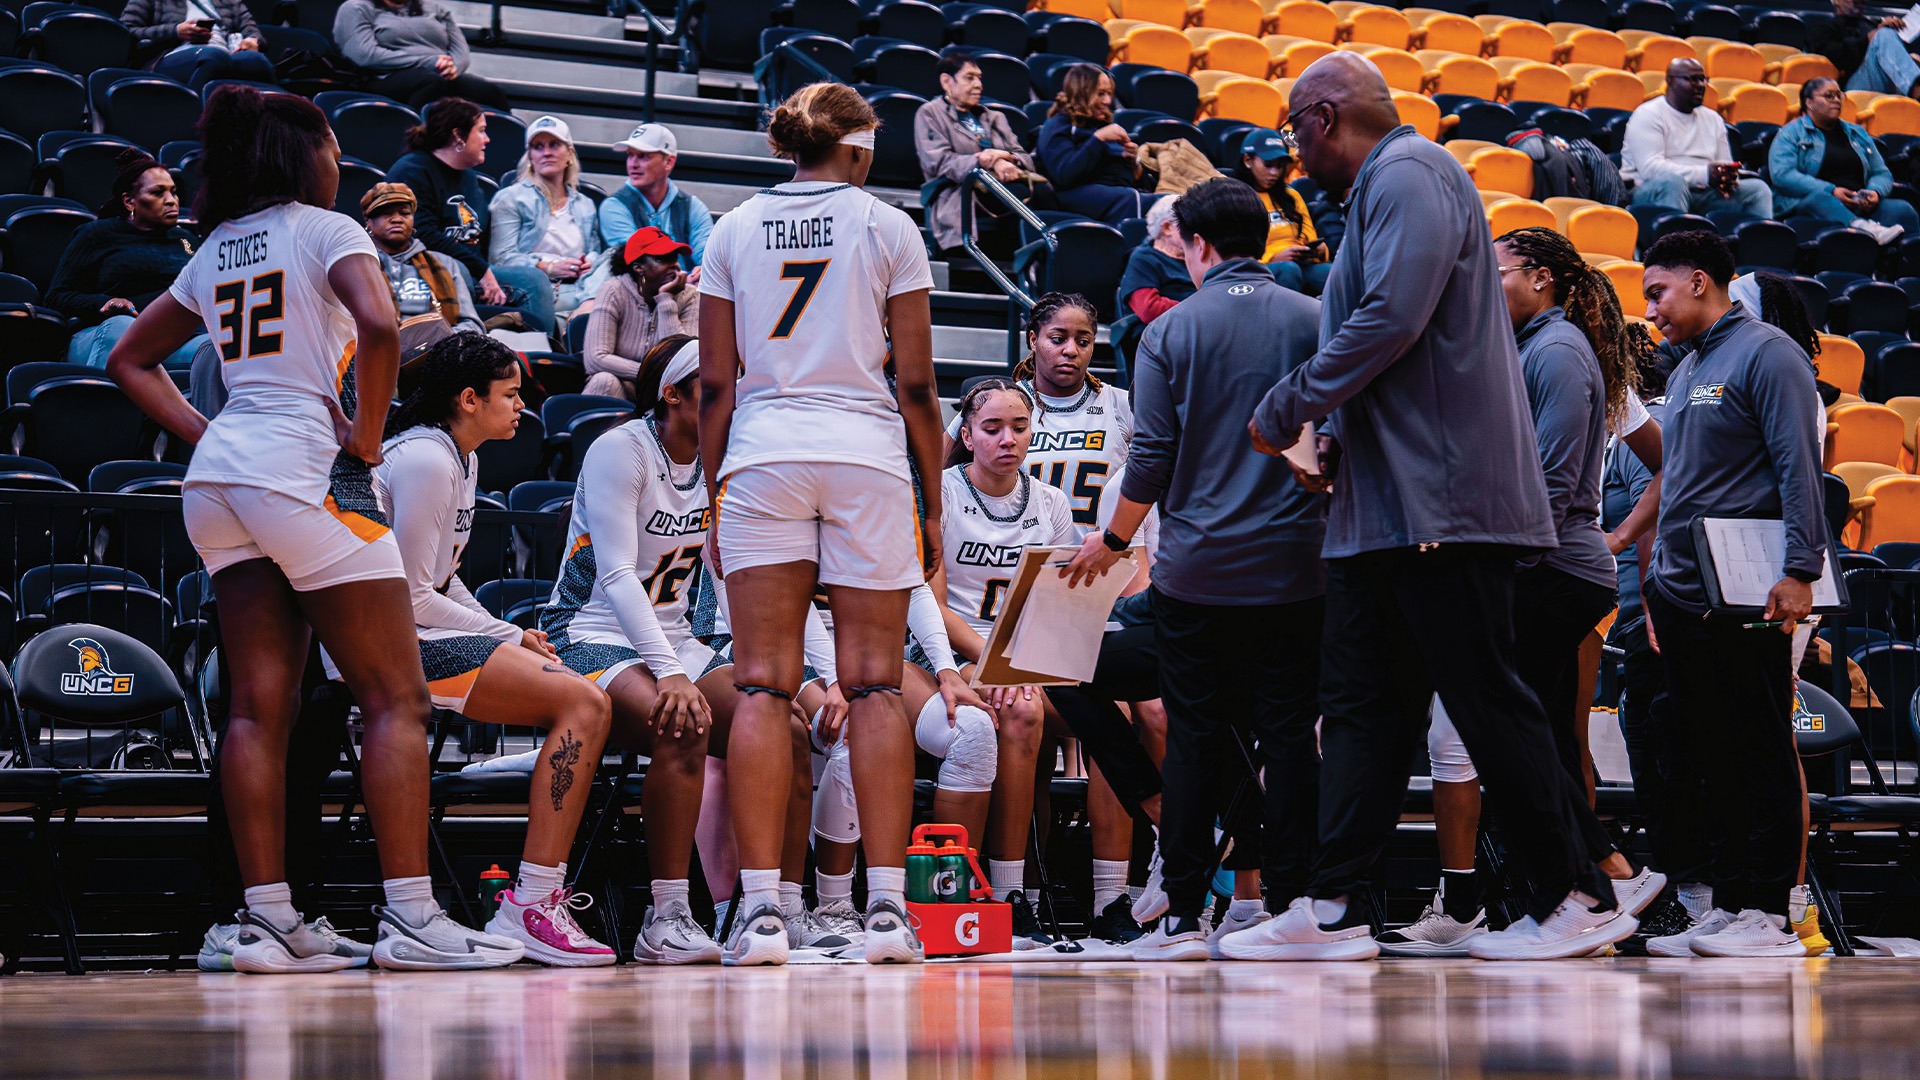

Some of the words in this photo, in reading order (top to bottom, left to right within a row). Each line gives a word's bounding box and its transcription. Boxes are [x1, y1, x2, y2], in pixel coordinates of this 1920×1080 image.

[762, 216, 833, 250] TRAORE
[217, 230, 268, 272] STOKES
[214, 268, 285, 363] 32
[767, 258, 832, 340] 7
[1691, 384, 1725, 399] UNCG
[957, 541, 1022, 567] UNC
[641, 543, 705, 606] 12
[62, 674, 133, 694] UNCG
[1792, 717, 1824, 731] NCG
[954, 912, 980, 946] G
